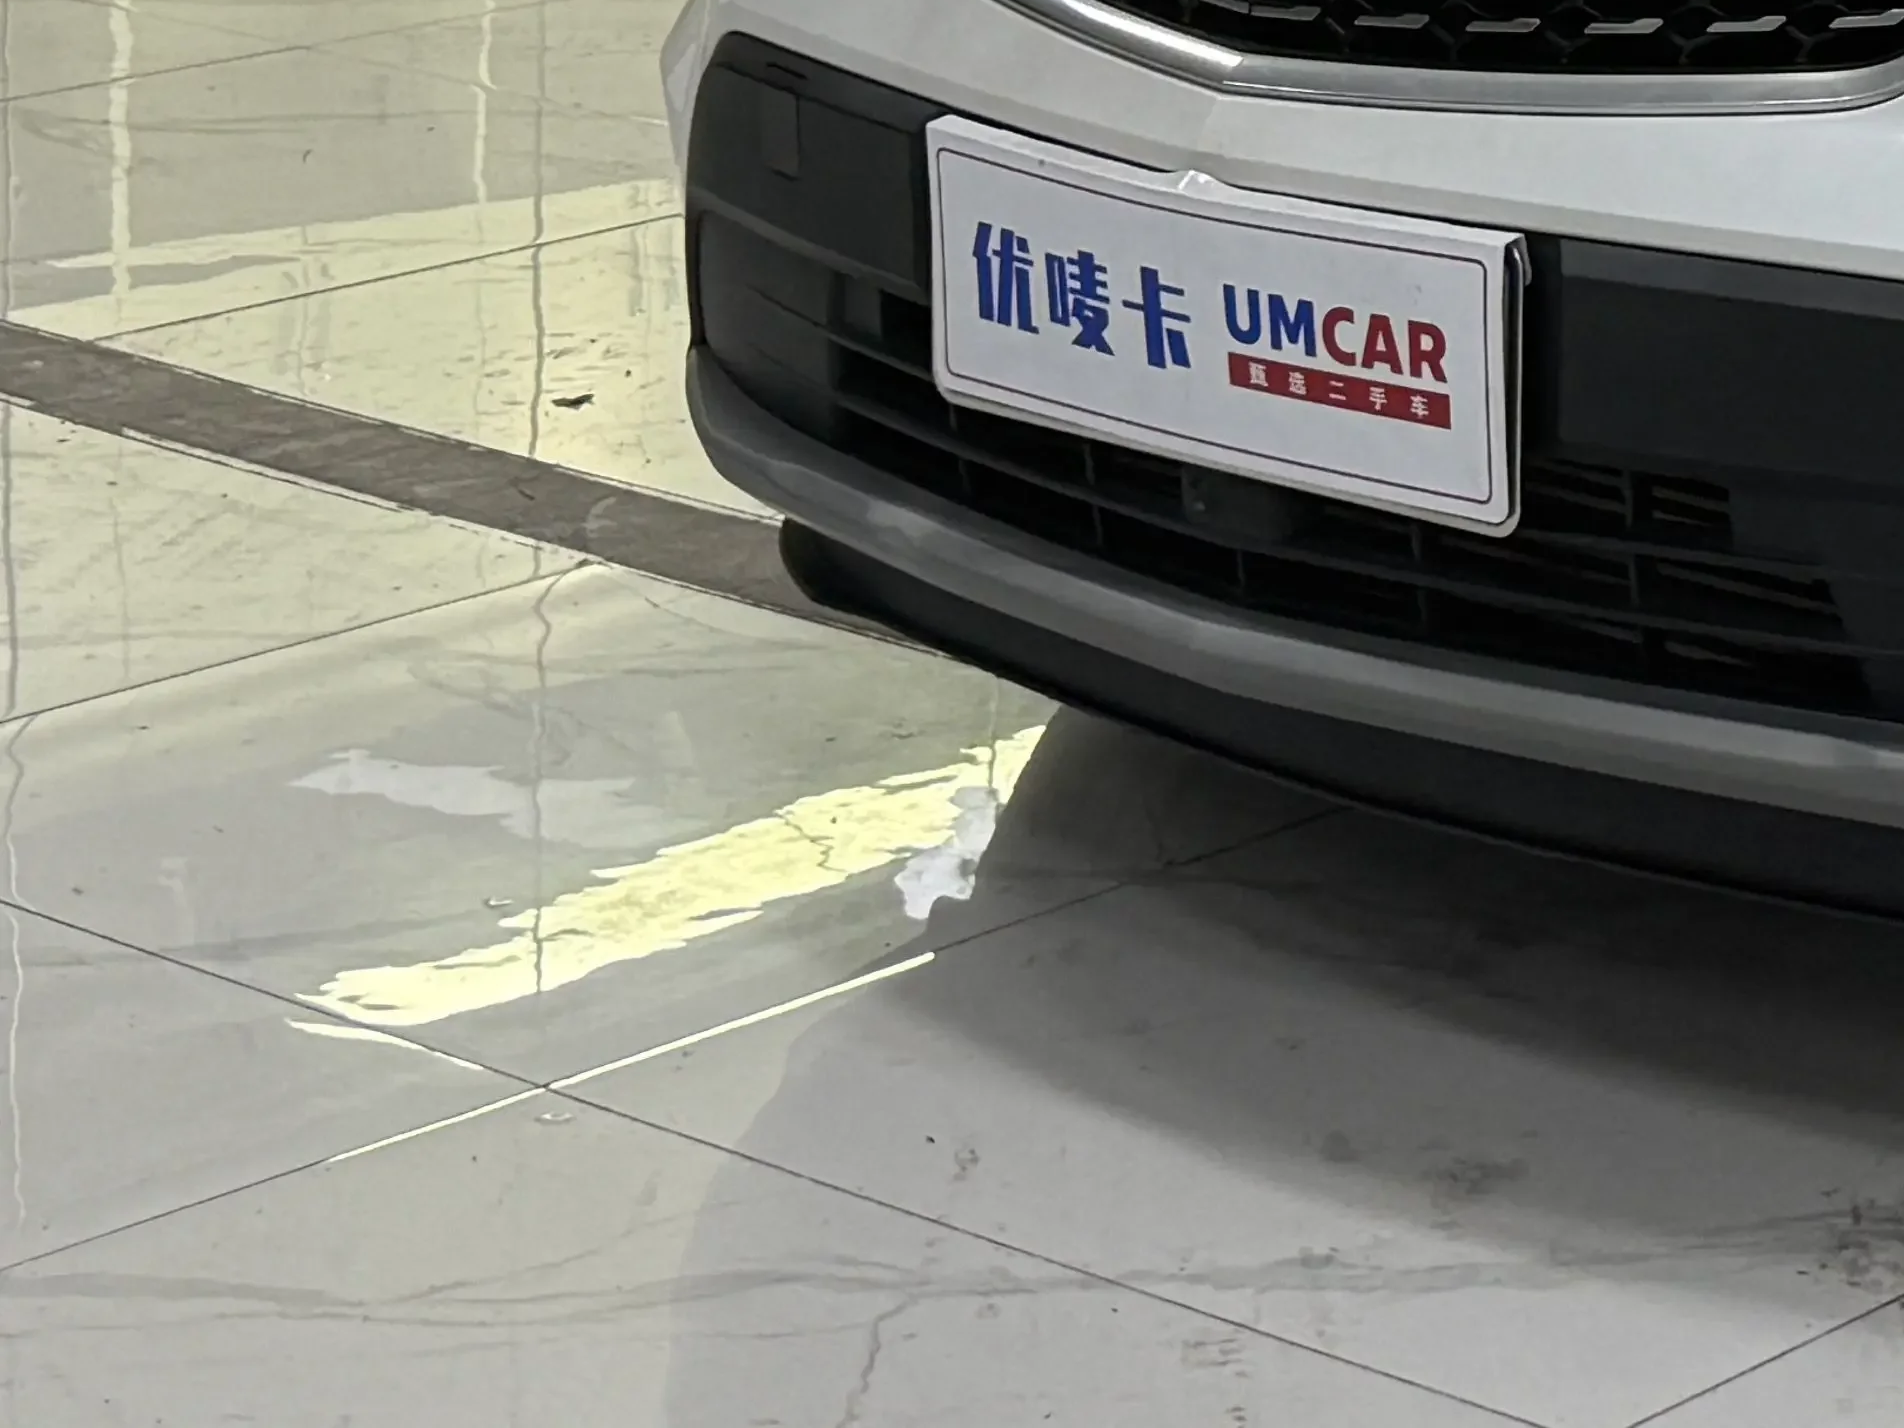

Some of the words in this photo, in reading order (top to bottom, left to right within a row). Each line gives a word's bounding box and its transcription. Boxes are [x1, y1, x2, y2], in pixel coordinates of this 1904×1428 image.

[972, 221, 1192, 370] 优唛卡
[1223, 283, 1448, 384] UMCAR
